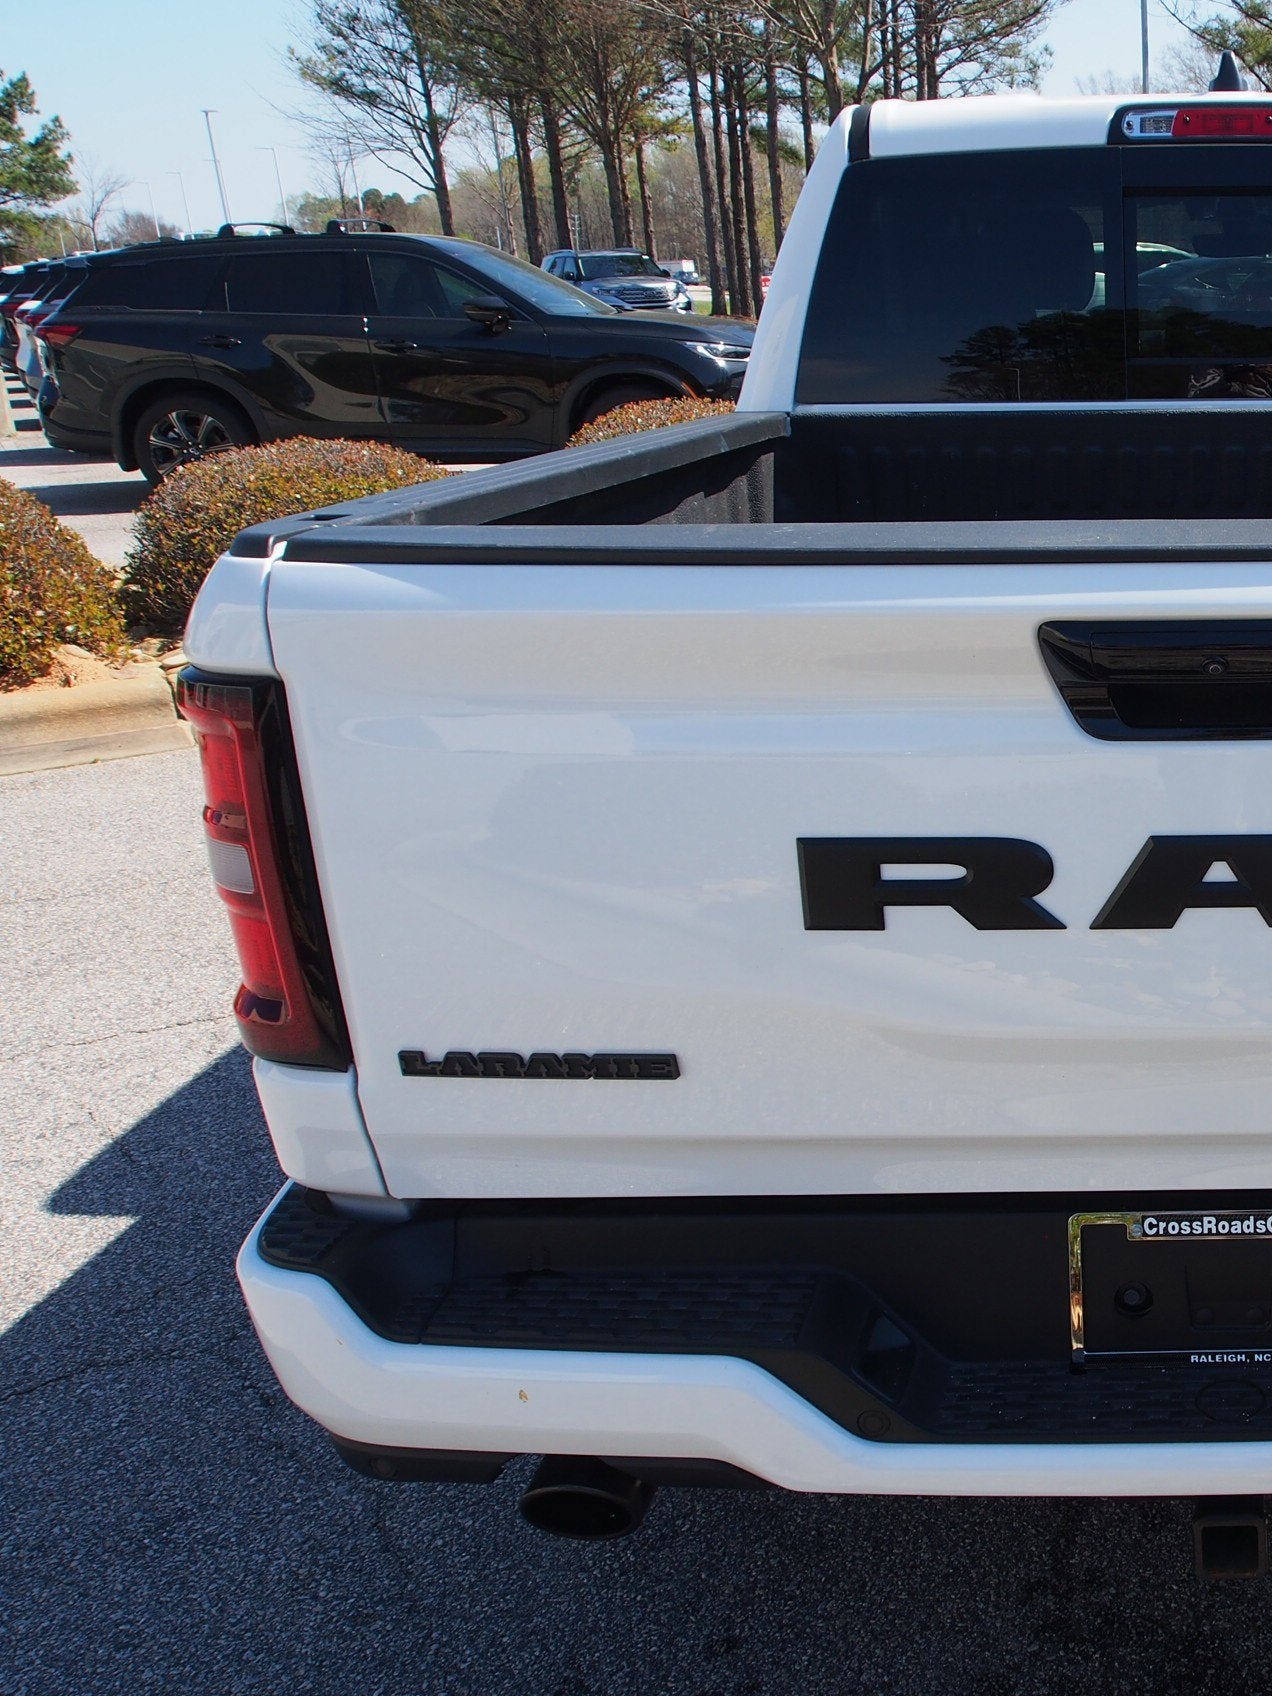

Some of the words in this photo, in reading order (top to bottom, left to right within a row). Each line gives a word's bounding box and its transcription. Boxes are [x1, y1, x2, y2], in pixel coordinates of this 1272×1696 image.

[398, 1050, 681, 1080] LARAMIE
[1190, 1354, 1250, 1363] RALEIGH,
[1254, 1353, 1272, 1362] NC
